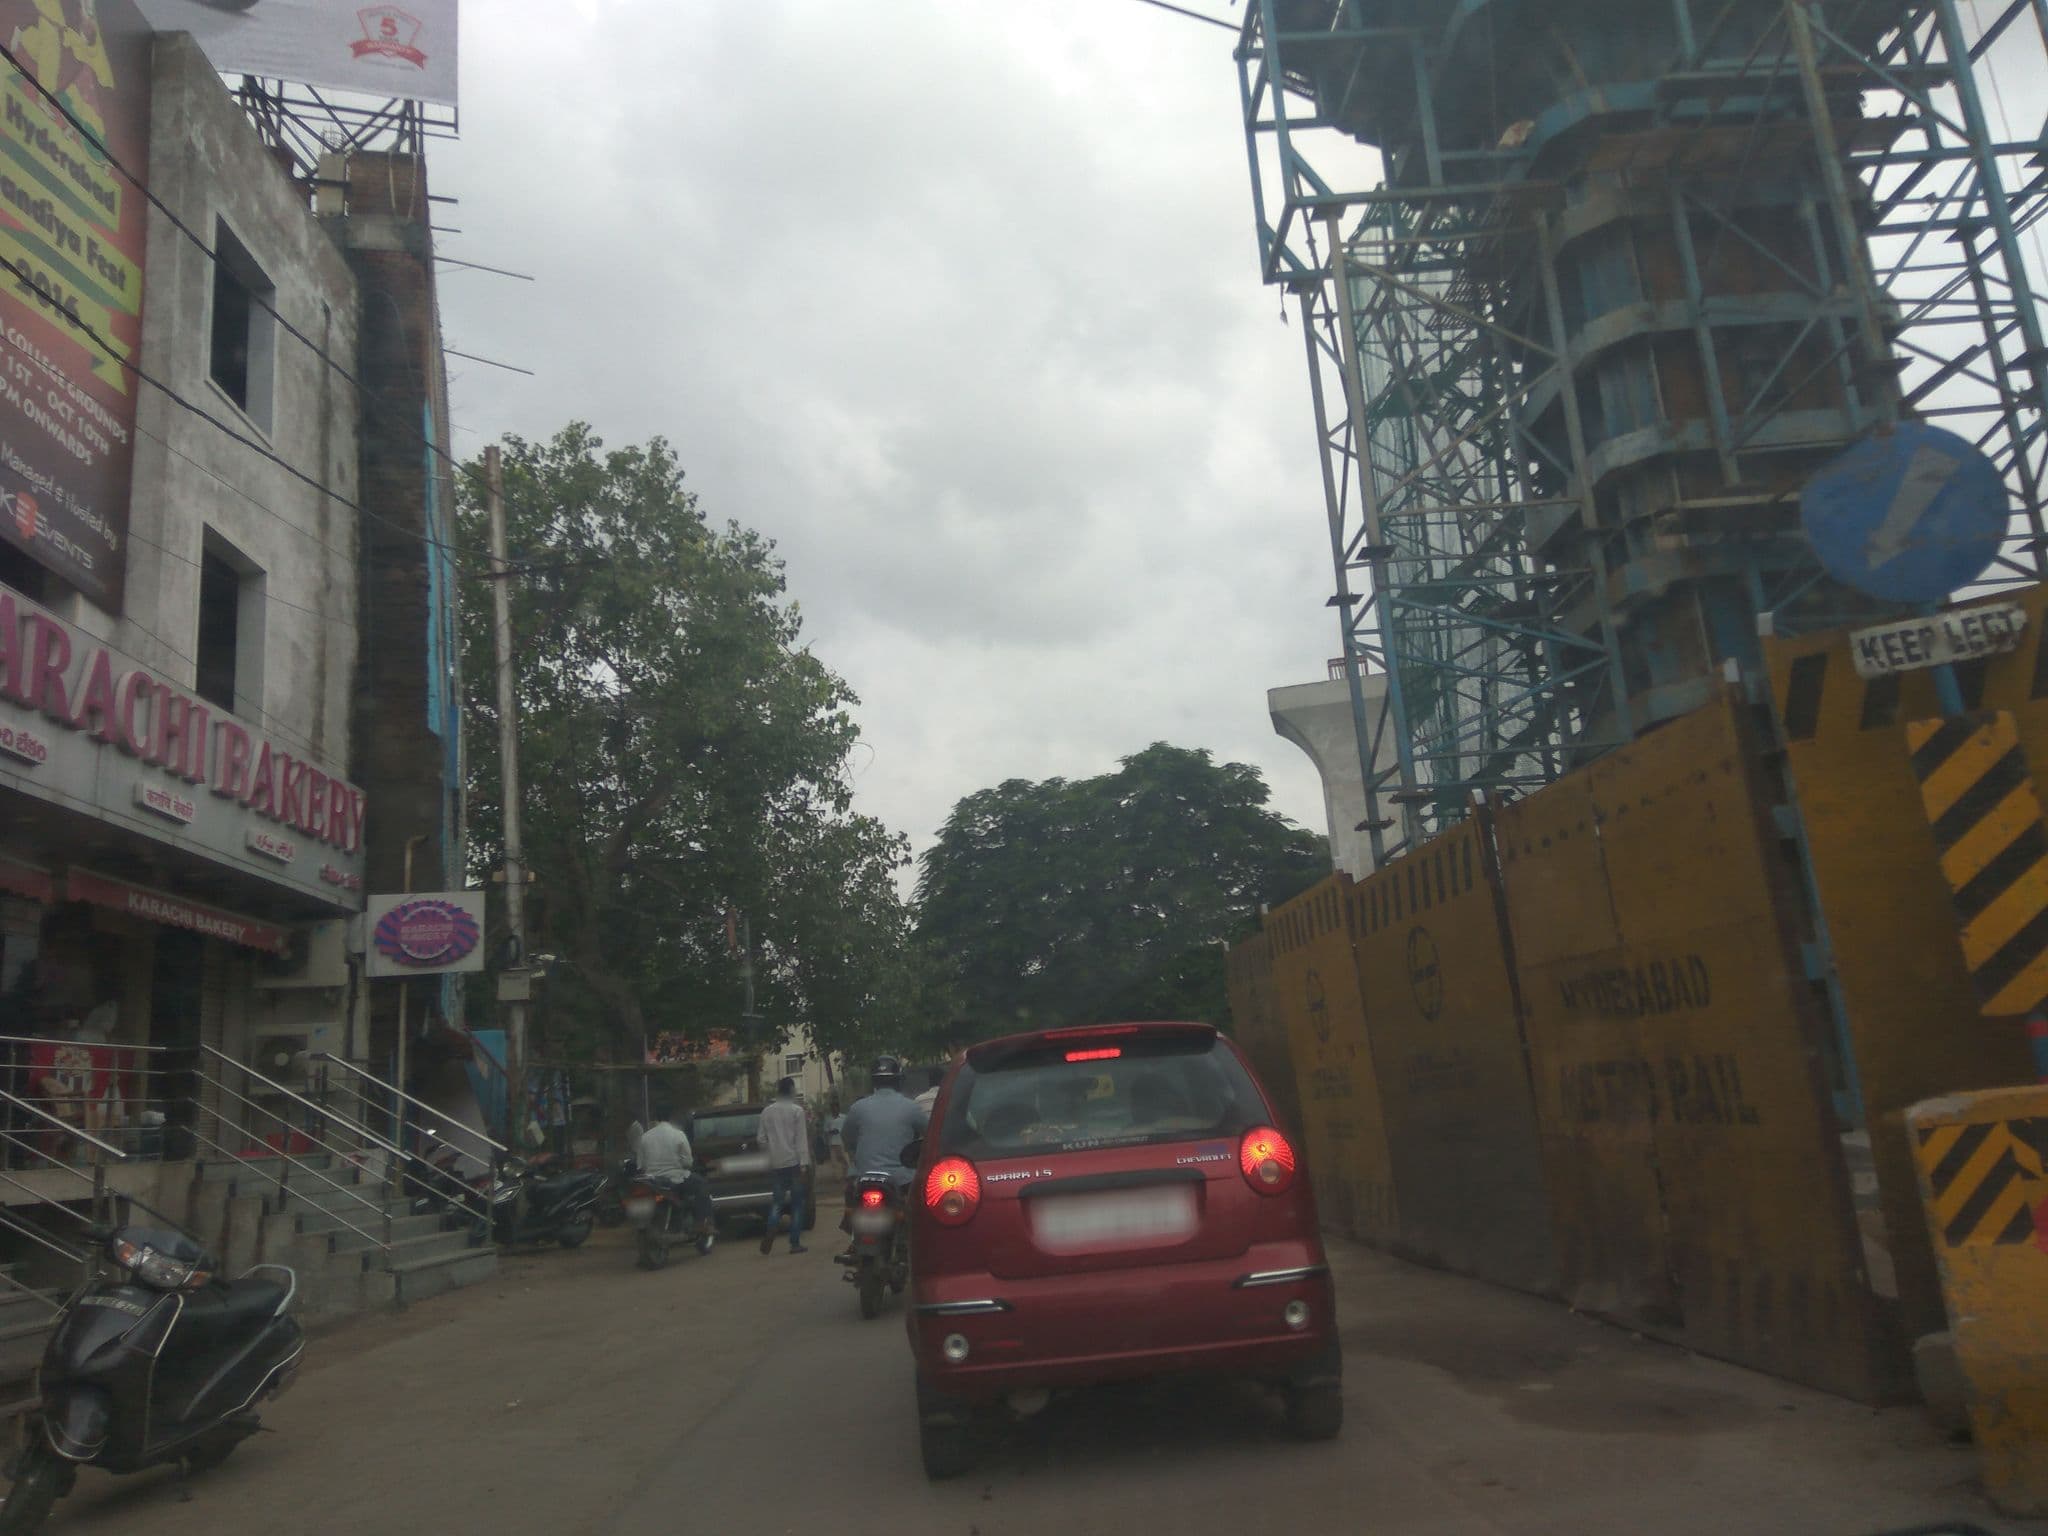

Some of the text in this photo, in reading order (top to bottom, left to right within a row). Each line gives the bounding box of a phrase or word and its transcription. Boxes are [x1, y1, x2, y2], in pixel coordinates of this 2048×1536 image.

[6, 93, 116, 216] Hyderabad
[86, 234, 127, 292] Fest
[7, 355, 33, 387] 1ST
[47, 390, 75, 423] OCT
[78, 416, 110, 455] 10TH
[8, 327, 65, 389] COLLEGE
[67, 382, 128, 444] GROUNDS
[23, 397, 93, 466] ONWARDS
[1858, 625, 1936, 668] KEEP
[212, 718, 367, 854] BAKERY
[128, 890, 246, 941] KARACHI BAKERY
[986, 1171, 1031, 1182] SPARK
[1176, 1153, 1233, 1164] CHEVROLET
